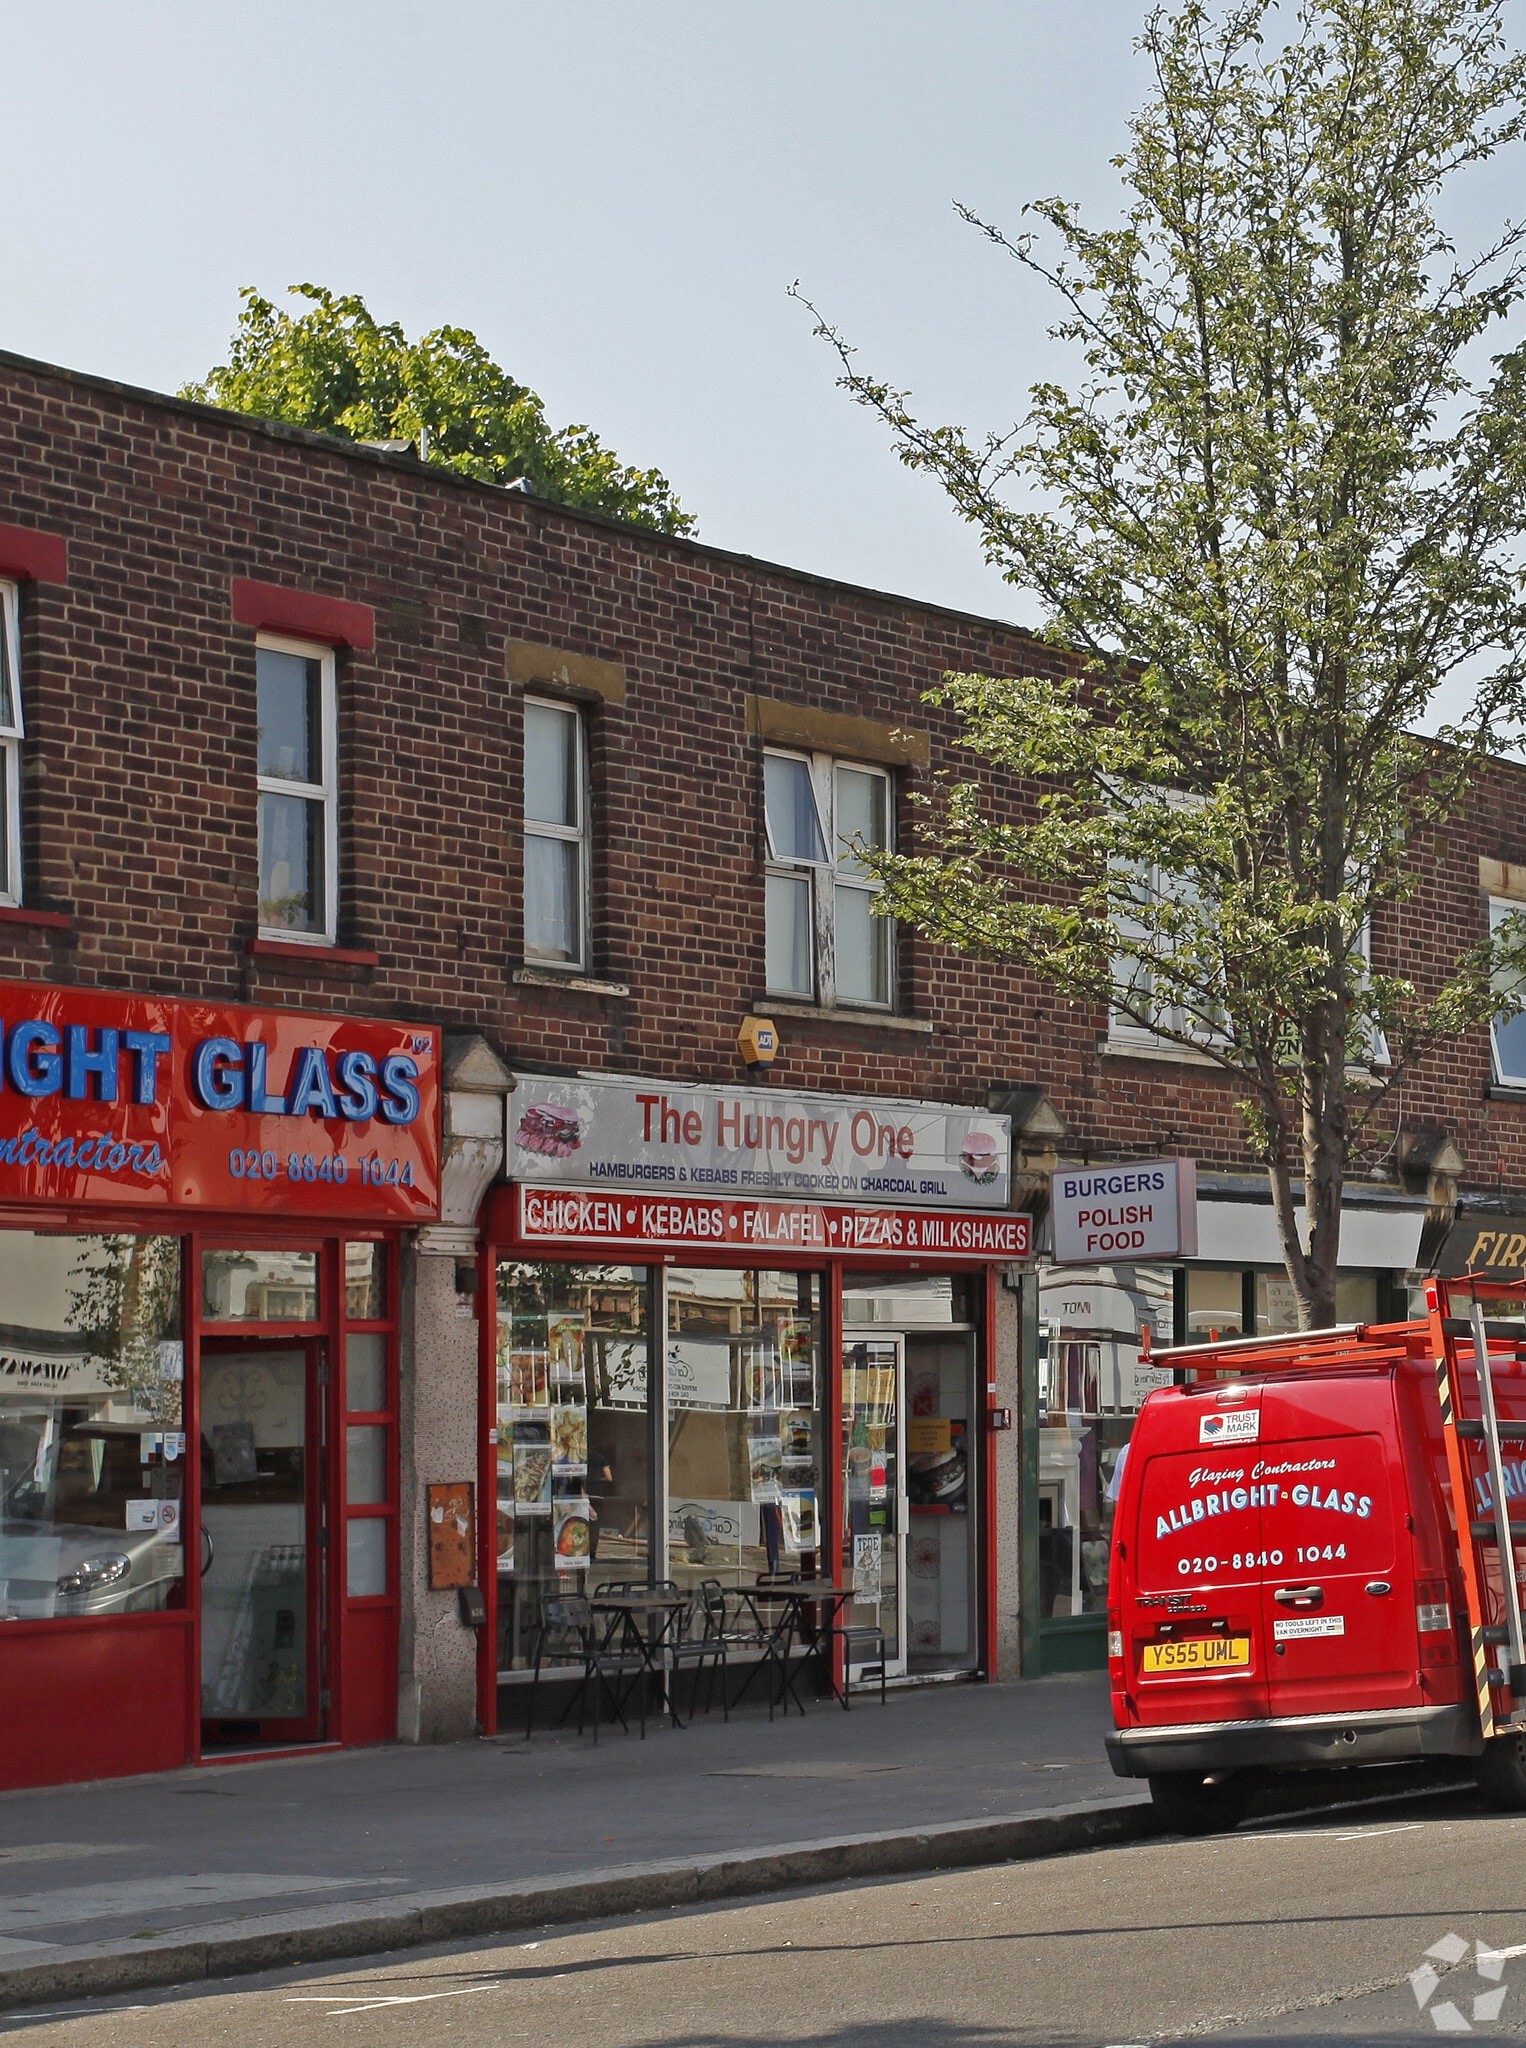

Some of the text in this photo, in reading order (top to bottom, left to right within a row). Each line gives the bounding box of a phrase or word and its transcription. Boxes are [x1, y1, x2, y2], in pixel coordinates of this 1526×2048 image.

[410, 1036, 433, 1055] 192
[0, 1018, 421, 1125] GHT GLASS
[635, 1094, 915, 1166] The Hungry One
[229, 1148, 414, 1188] 020 8840 1044
[589, 1161, 947, 1195] HAMBURGERS & KEBABS FRESHLY COOKED ON CHARCOAL GRILL
[1063, 1172, 1165, 1199] BURGERS
[527, 1198, 1027, 1250] CHICKEN KEBABS FALAFEL PIZZAS & MILKSHAKES
[1078, 1204, 1153, 1229] POLISH
[1086, 1229, 1145, 1253] FOOD
[1465, 1231, 1526, 1267] FIR
[1226, 1412, 1257, 1424] TRUST
[1226, 1422, 1256, 1433] MARK
[1188, 1457, 1337, 1489] Glazing Contractors
[1155, 1483, 1373, 1540] ALLBRIGHT GLASS
[1177, 1543, 1348, 1575] 020-8840 1044
[1285, 1620, 1304, 1628] TOOLS
[1305, 1618, 1319, 1626] LEFT
[1289, 1626, 1322, 1634] OVERNIGHT
[1153, 1640, 1240, 1666] YS55 UML
